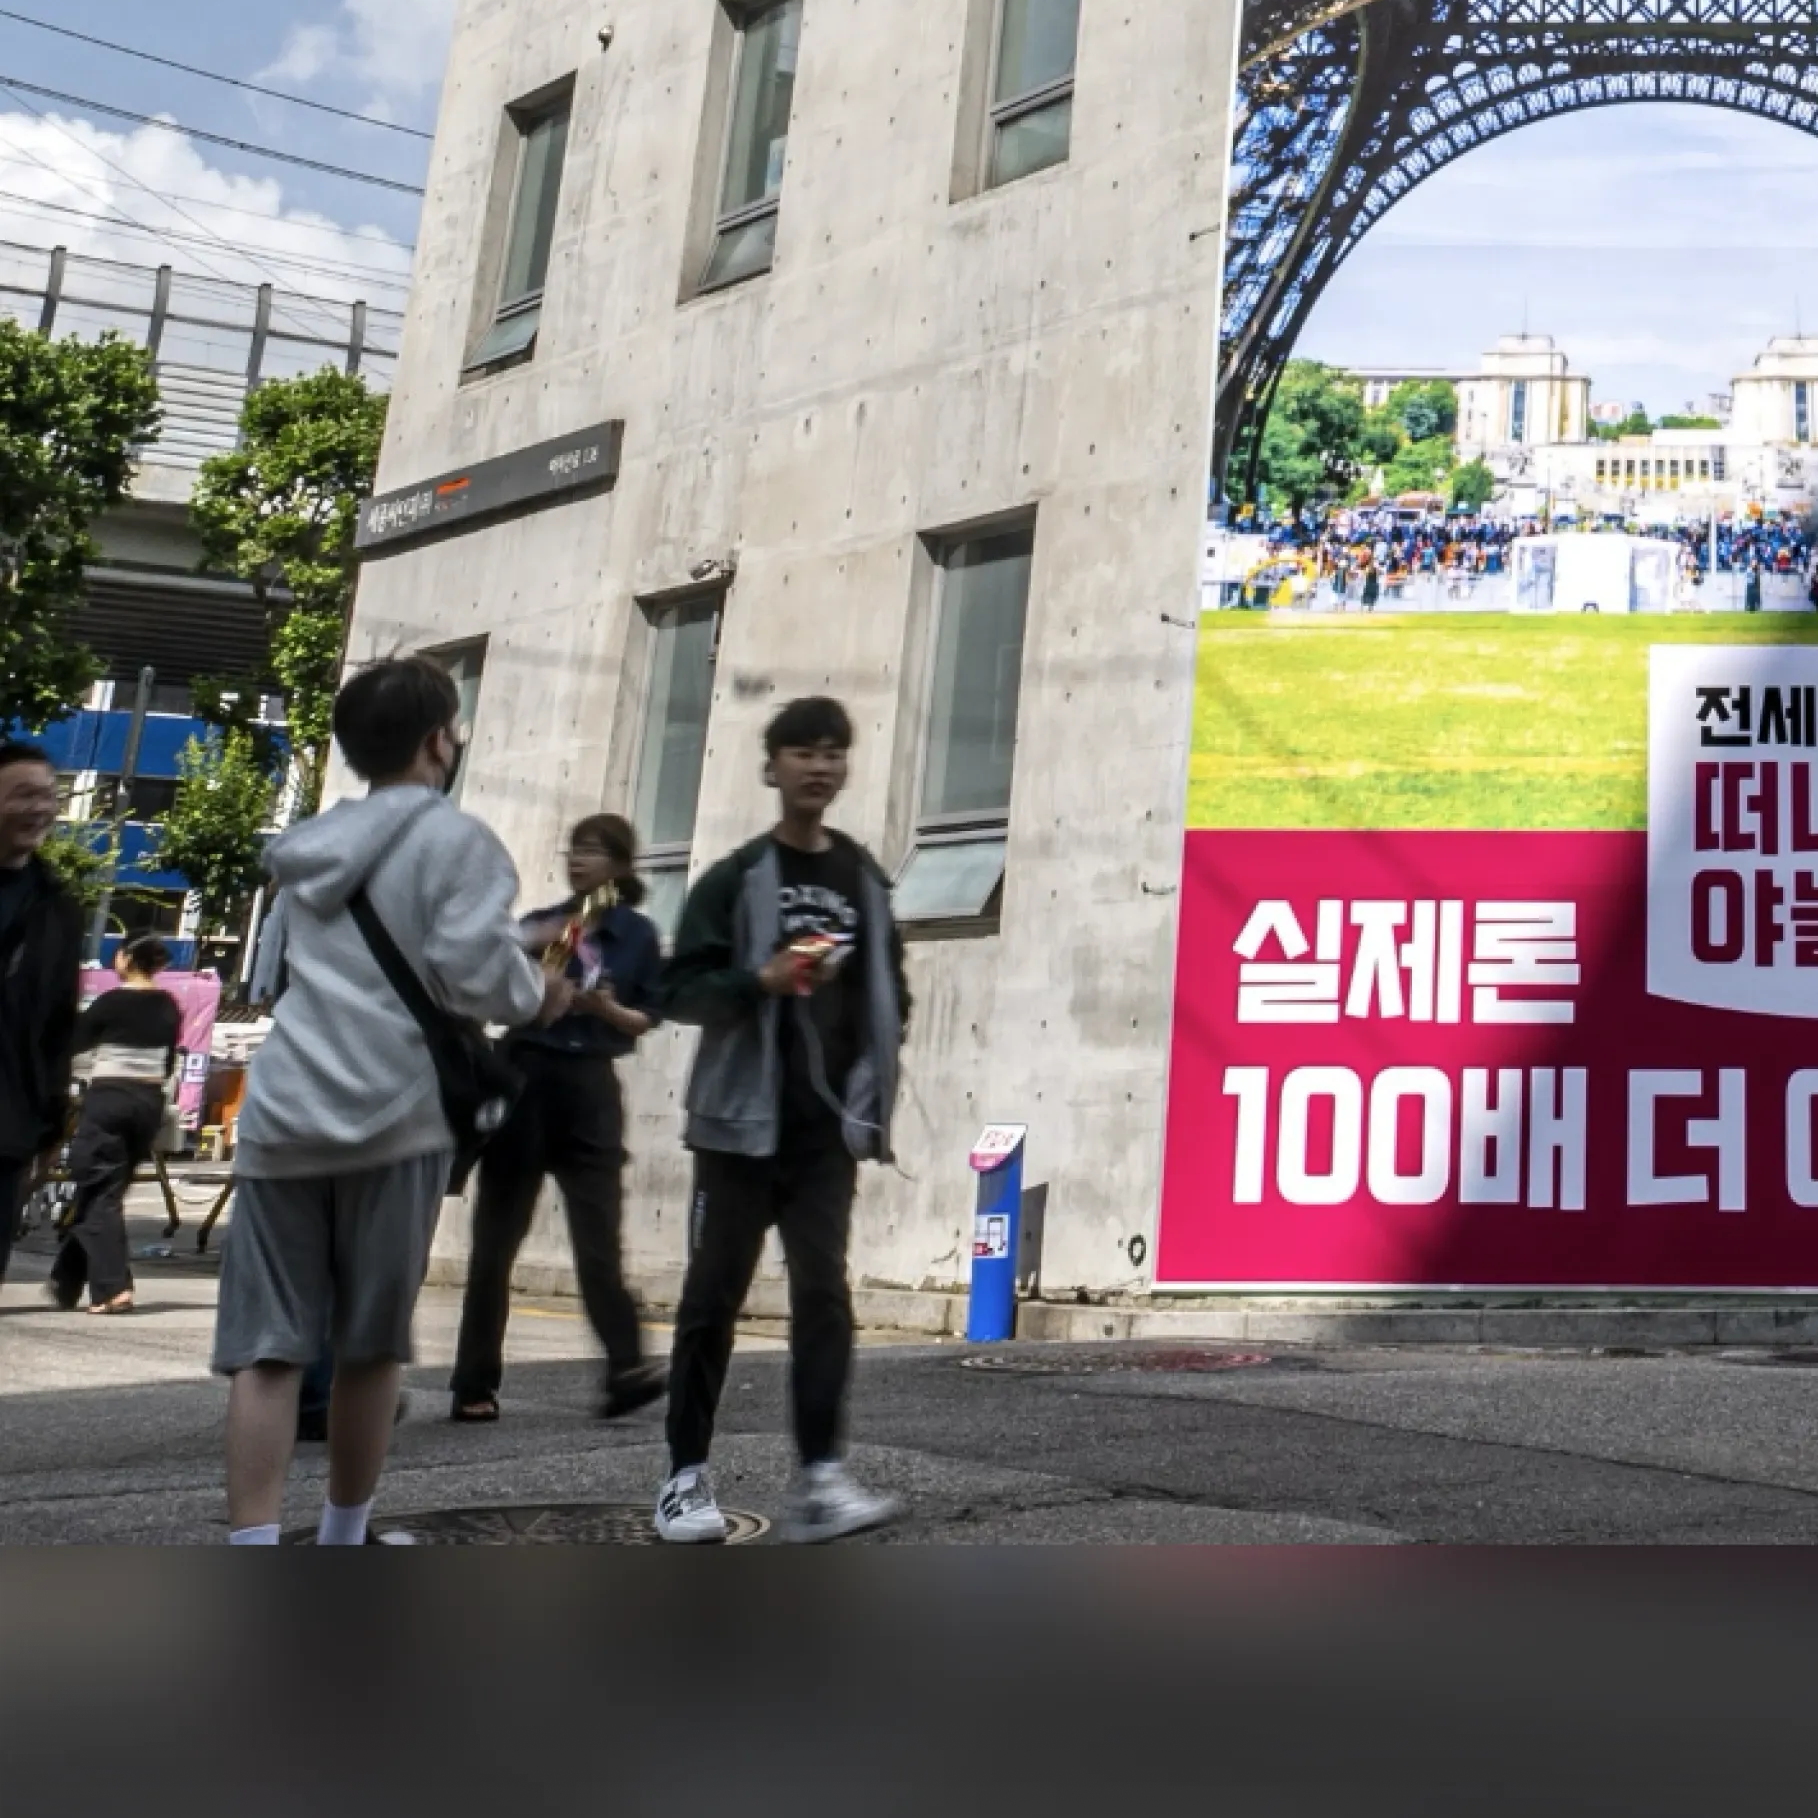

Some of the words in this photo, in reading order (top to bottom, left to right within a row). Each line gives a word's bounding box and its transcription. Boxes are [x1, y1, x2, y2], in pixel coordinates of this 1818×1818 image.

[1233, 900, 1579, 1023] 실제론
[1223, 1066, 1586, 1210] 100배
[1627, 1069, 1745, 1210] 더
